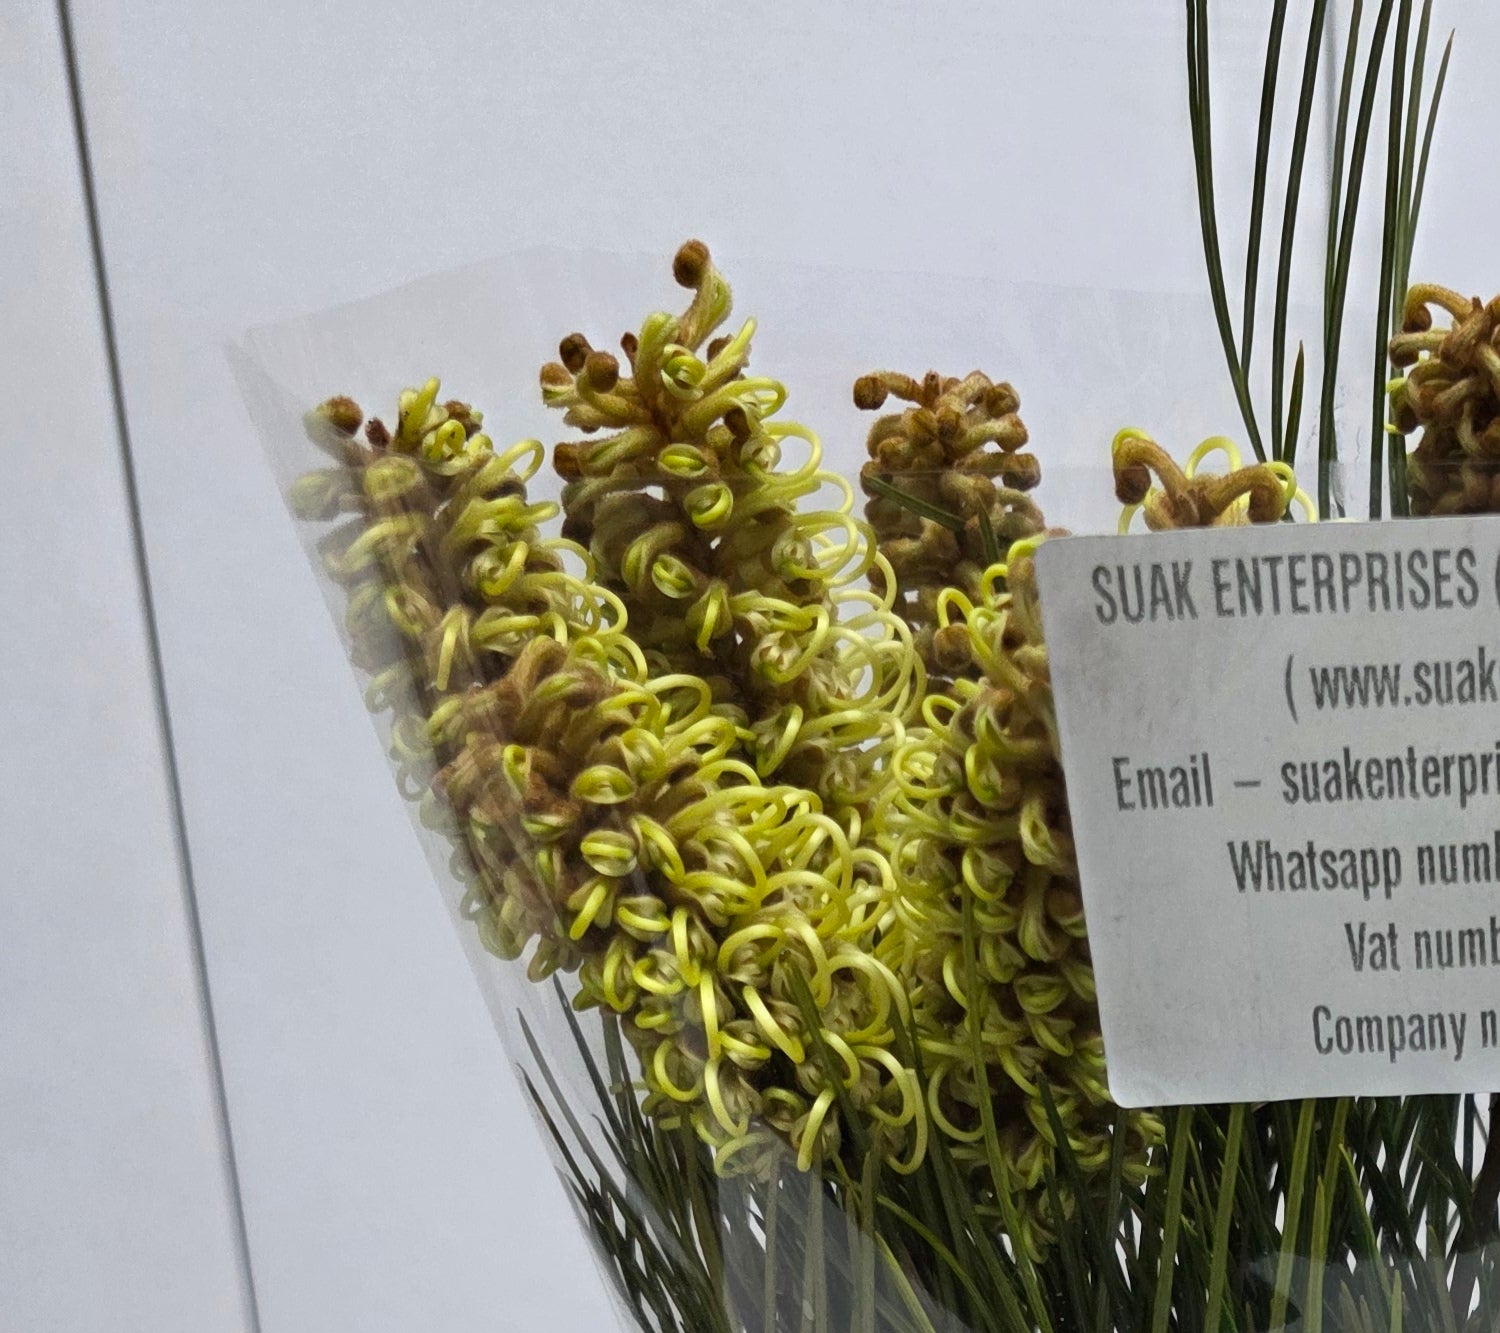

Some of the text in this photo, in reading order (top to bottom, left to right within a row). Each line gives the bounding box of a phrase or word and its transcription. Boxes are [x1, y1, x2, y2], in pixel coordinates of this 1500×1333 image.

[1092, 561, 1198, 625] SUAK
[1211, 548, 1479, 617] ENTERPRISES
[1285, 655, 1297, 723] (
[1112, 752, 1213, 811] Email
[1227, 840, 1401, 901] Whatsapp
[1344, 922, 1400, 971] Vat
[1313, 1005, 1466, 1063] Company
